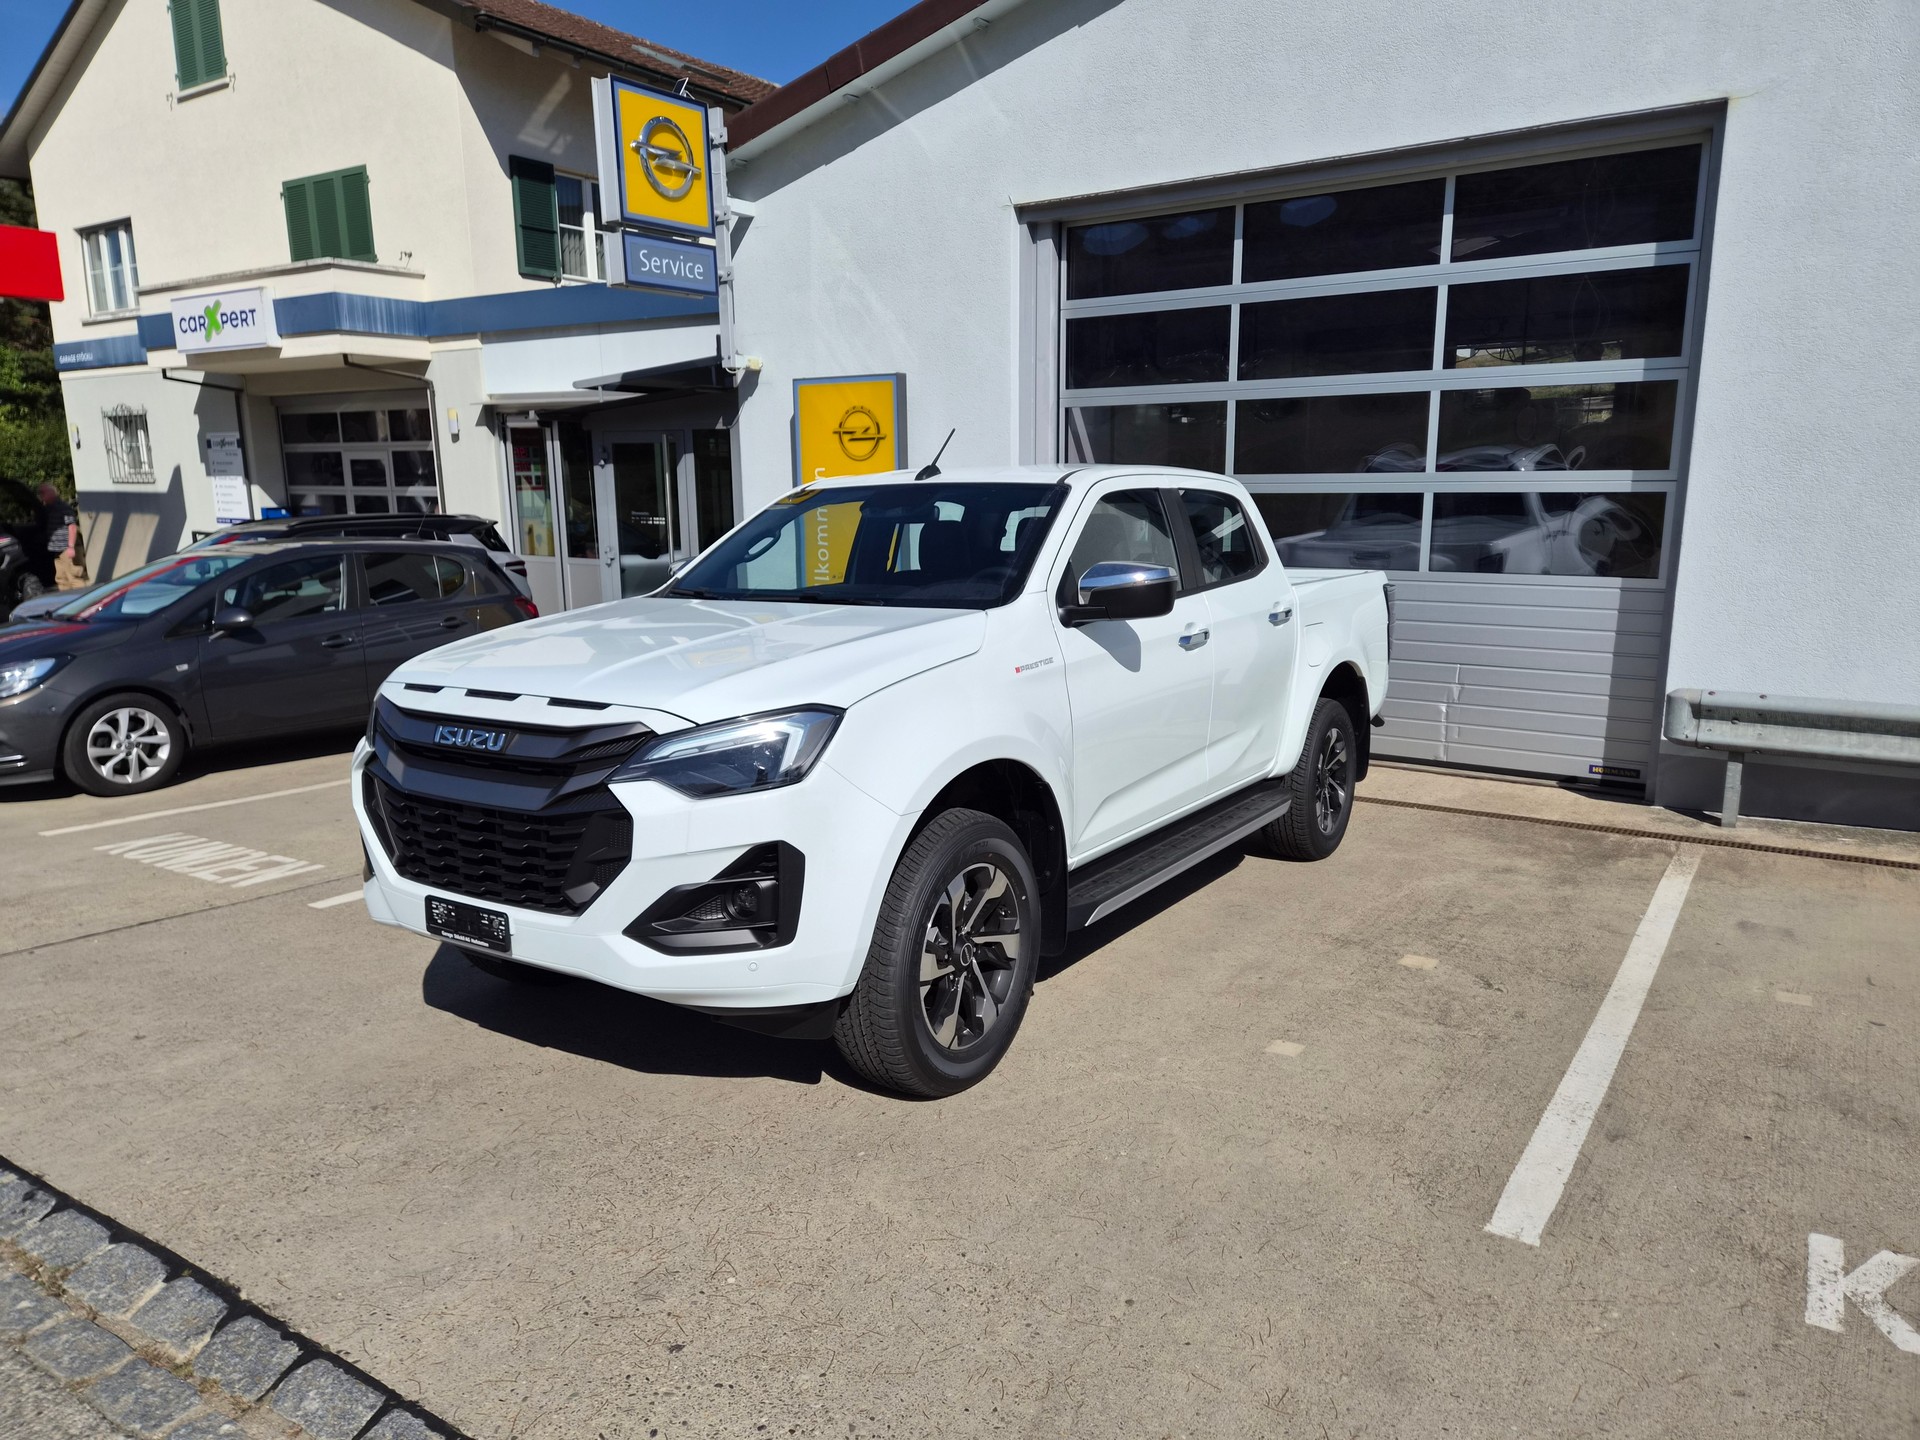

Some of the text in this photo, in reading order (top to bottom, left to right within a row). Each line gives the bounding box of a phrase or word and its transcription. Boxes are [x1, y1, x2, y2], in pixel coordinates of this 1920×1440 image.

[639, 249, 704, 280] Service
[434, 725, 506, 751] ISUZU
[92, 831, 326, 889] KUNDEN
